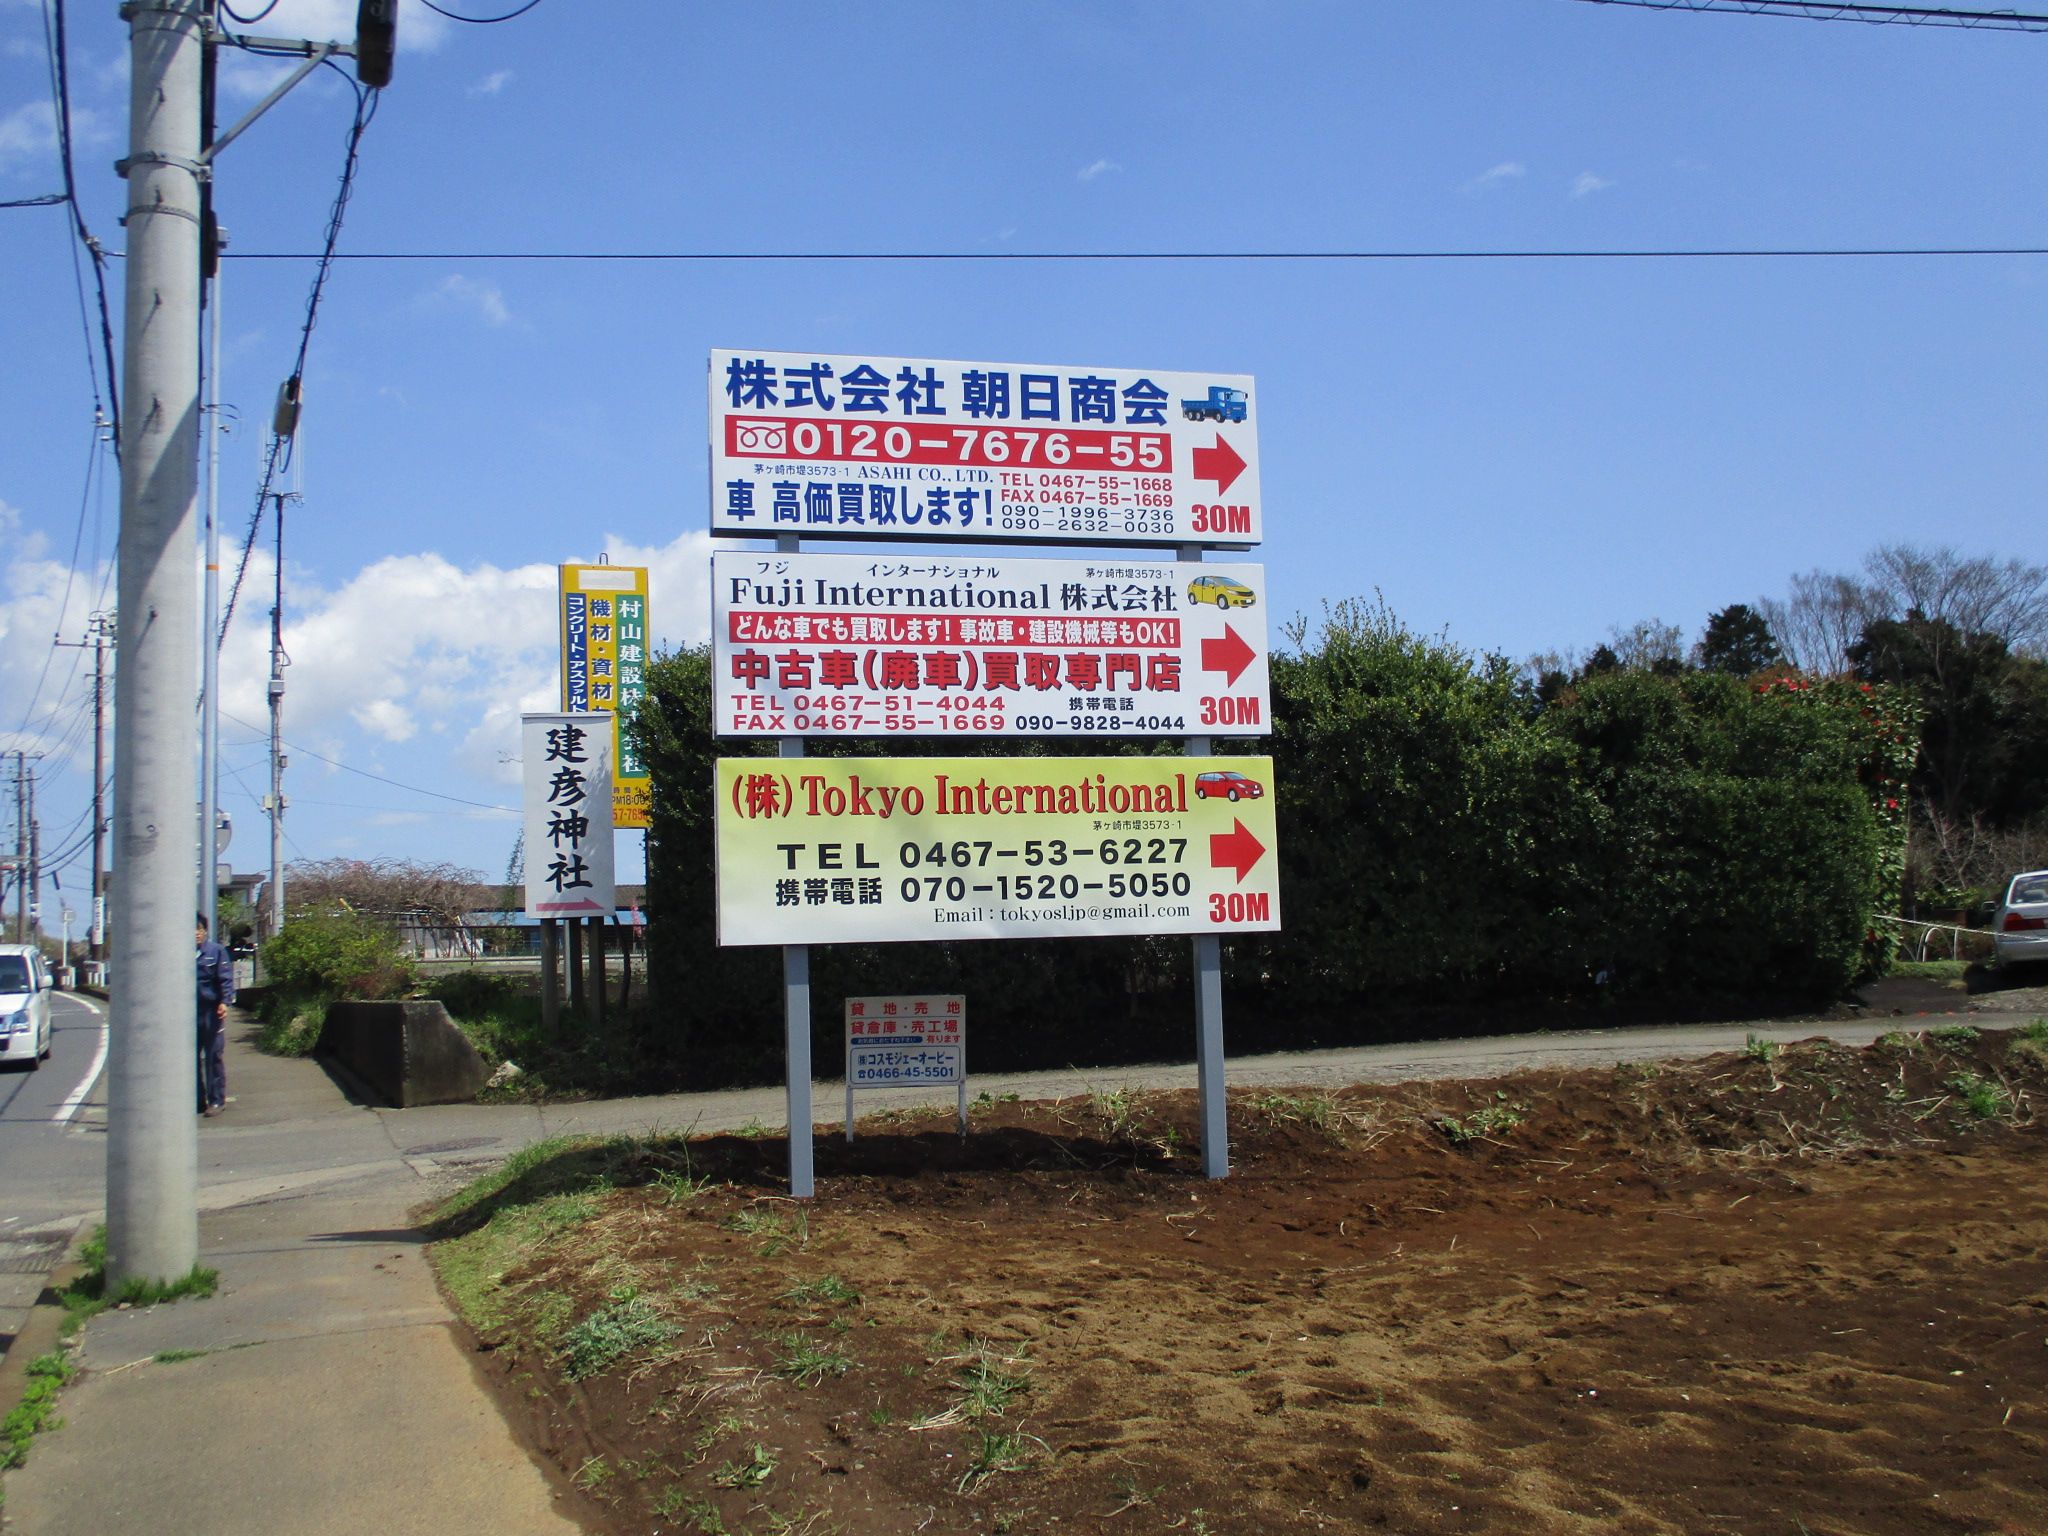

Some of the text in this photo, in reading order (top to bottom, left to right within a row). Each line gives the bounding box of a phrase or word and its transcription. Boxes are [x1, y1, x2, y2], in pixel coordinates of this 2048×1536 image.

[726, 357, 1170, 426] 株式会社 朝日商会
[791, 422, 1164, 469] 0120-7676-55
[857, 465, 912, 480] ASAHI
[955, 469, 994, 483] LTD.
[1000, 473, 1173, 491] TEL 0467-55-1668
[727, 479, 993, 527] 車 高価買取します!
[1001, 489, 1173, 507] FAX 0467-55-1669
[1001, 505, 1174, 521] 090-1996-3736
[1002, 518, 1174, 533] 090-2632-0030
[1191, 505, 1251, 534] 30M
[757, 561, 790, 575] フジ
[867, 563, 1000, 579] インターナショナル
[729, 577, 1178, 612] Fuji International 株式会社
[736, 615, 1175, 645] どんな車でも買取します! 事故車・建設機械等もOK!
[590, 598, 613, 713] 機材・資材
[731, 649, 1182, 692] 中古車(廃車)買取専門店
[731, 695, 1006, 711] TEL 0467-51-4044
[1068, 697, 1134, 711] 携帯電話
[1200, 696, 1261, 726] 30M
[733, 714, 1006, 731] FAX 0467-55-1669
[1015, 715, 1186, 731] 090-9828-4044
[545, 723, 593, 893] 建彦神社
[800, 775, 925, 818] Tokyo
[934, 773, 1189, 816] International
[776, 837, 1189, 870] TEL 0467-53-6227
[775, 872, 1192, 907] 携帯電話 070-1520-5050
[1208, 892, 1270, 924] 30M
[867, 1067, 954, 1079] 0466-45-5501
